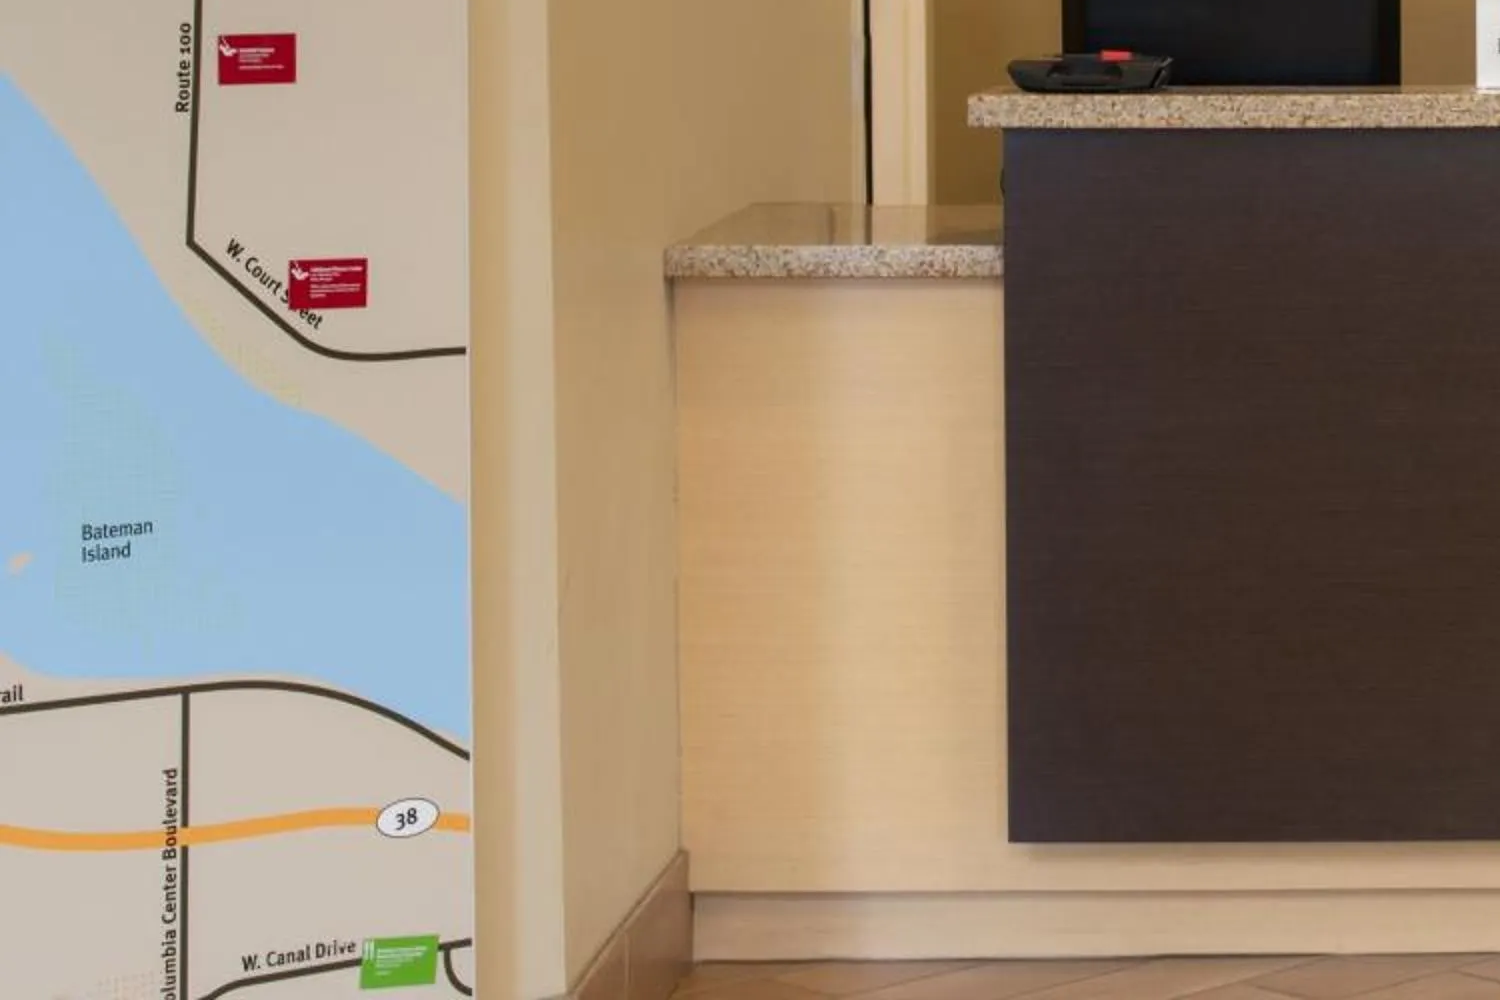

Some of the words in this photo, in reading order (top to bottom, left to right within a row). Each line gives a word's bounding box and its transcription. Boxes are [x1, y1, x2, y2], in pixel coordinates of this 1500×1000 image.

[180, 22, 191, 54] 100
[175, 59, 191, 113] Route
[225, 237, 244, 263] W.
[245, 257, 282, 296] Court
[82, 520, 153, 541] Bateman
[82, 540, 131, 563] Island
[0, 684, 23, 702] ail
[162, 767, 177, 860] Boulevard
[395, 807, 418, 831] 38
[161, 866, 177, 924] Center
[242, 953, 261, 972] W.
[266, 943, 311, 967] Canal
[315, 939, 356, 960] Drive
